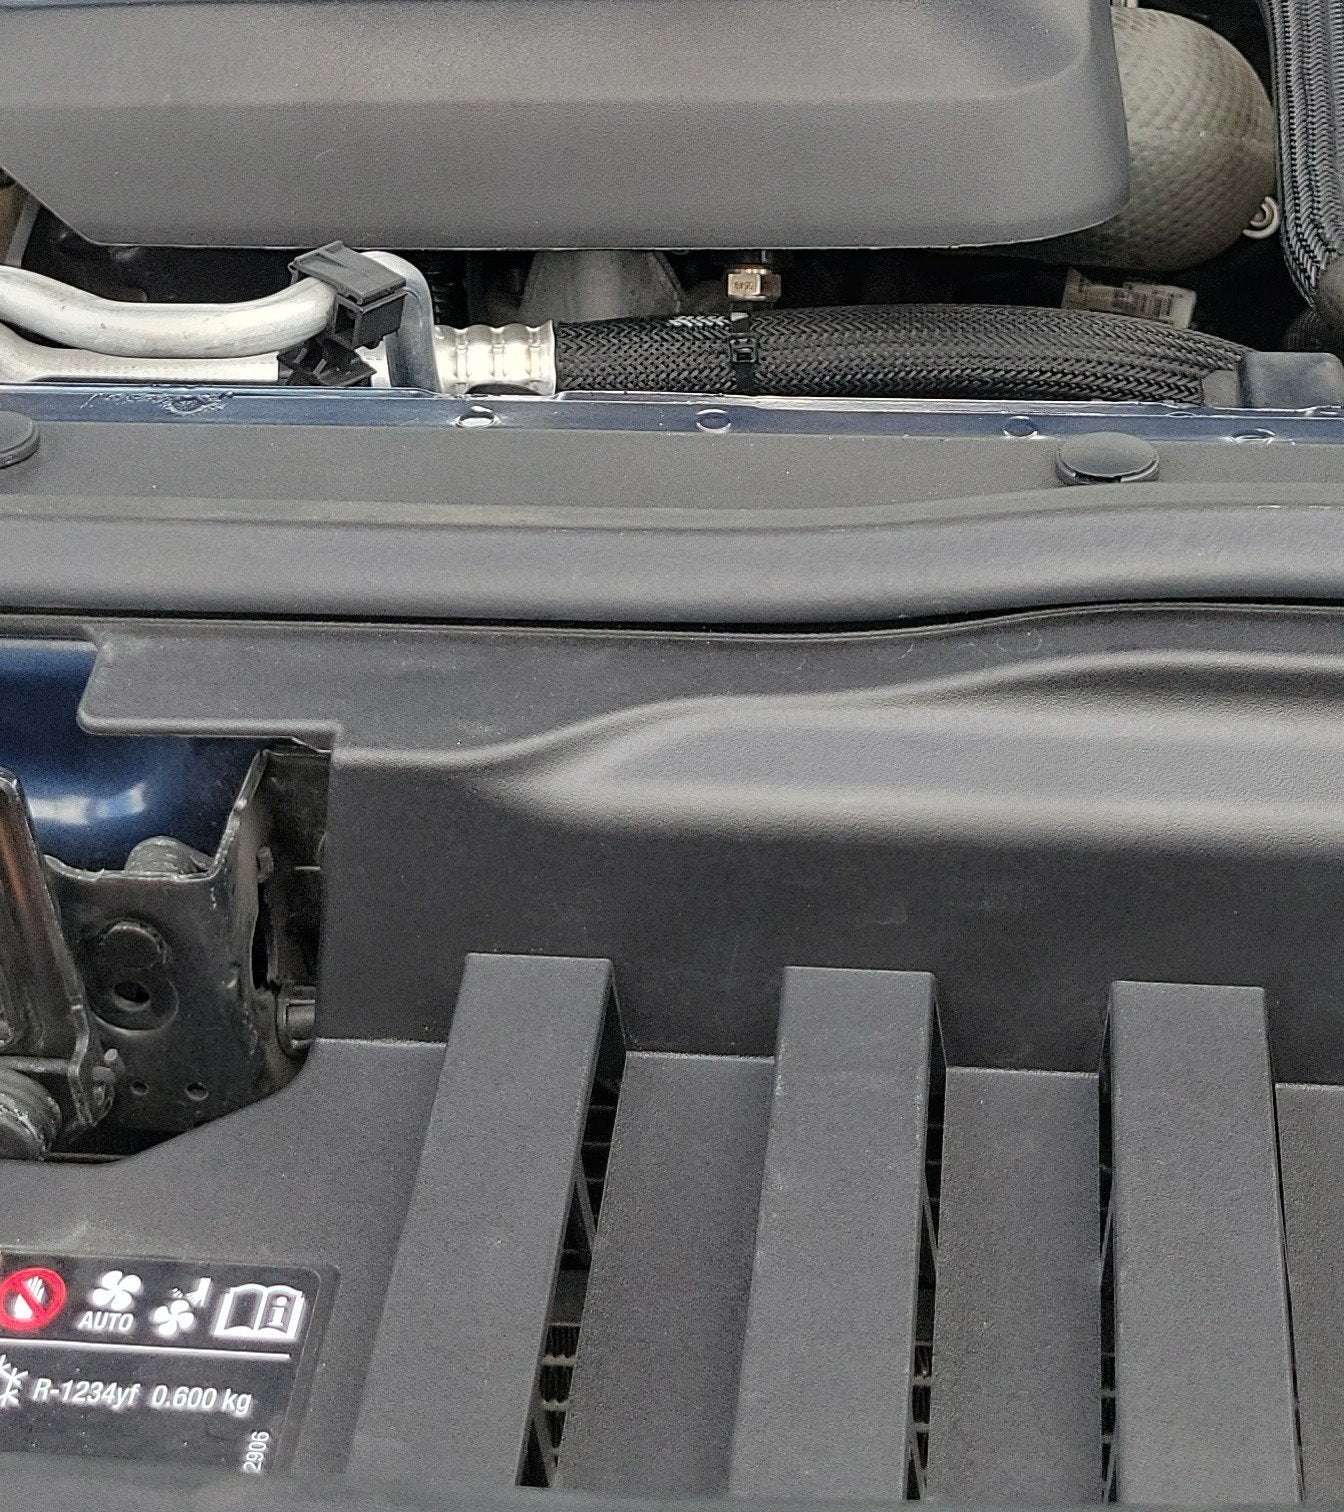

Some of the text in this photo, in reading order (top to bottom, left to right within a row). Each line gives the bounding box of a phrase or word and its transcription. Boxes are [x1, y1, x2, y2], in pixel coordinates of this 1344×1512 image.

[78, 1311, 134, 1333] AUTO
[32, 1378, 253, 1418] R-1234yf 0.600 kg
[242, 1430, 271, 1473] 2906
